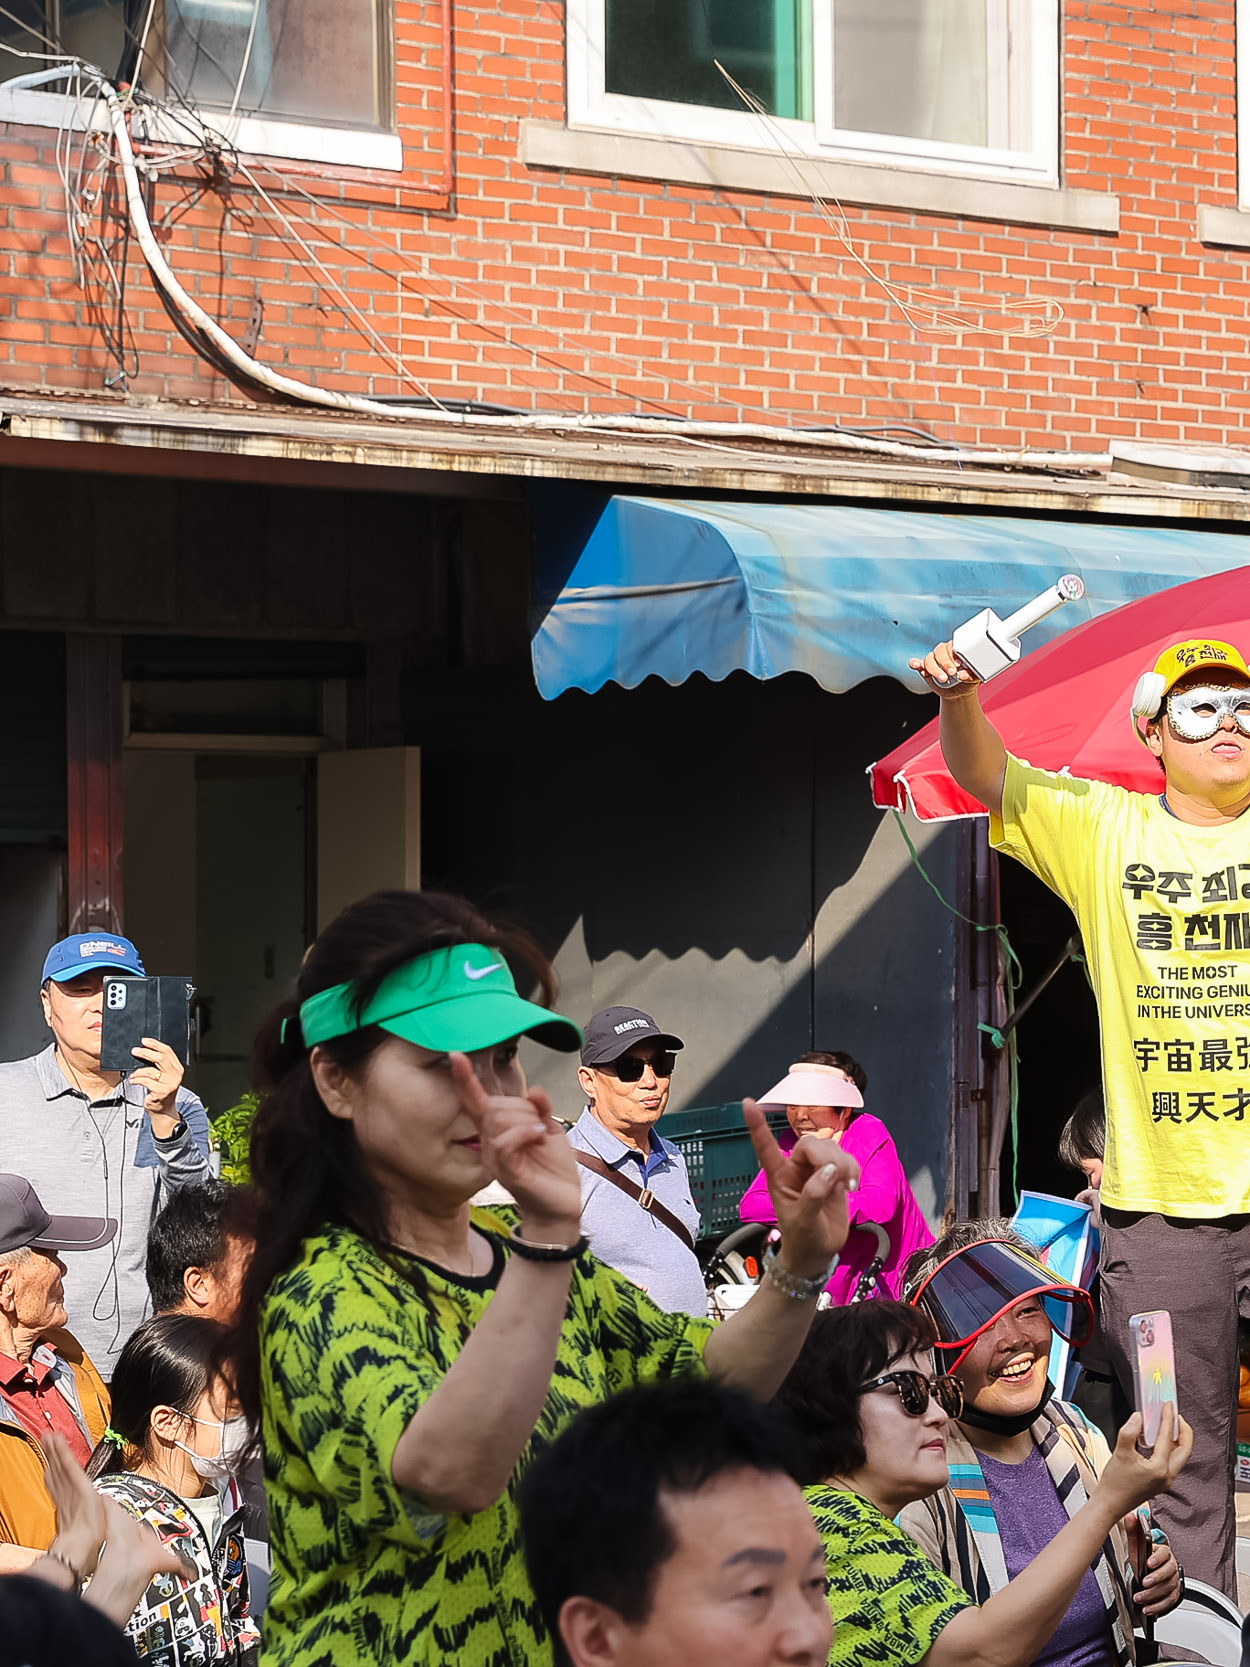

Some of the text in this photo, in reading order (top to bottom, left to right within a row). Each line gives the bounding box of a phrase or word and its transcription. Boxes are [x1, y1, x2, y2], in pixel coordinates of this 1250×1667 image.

[1122, 863, 1193, 904] 우주
[1136, 912, 1173, 951] 흥
[1157, 965, 1238, 981] THE MOST
[1136, 985, 1203, 1000] EXCITING
[1137, 1004, 1150, 1019] IN
[1152, 1005, 1181, 1019] THE
[842, 1562, 868, 1594] ZUMBA
